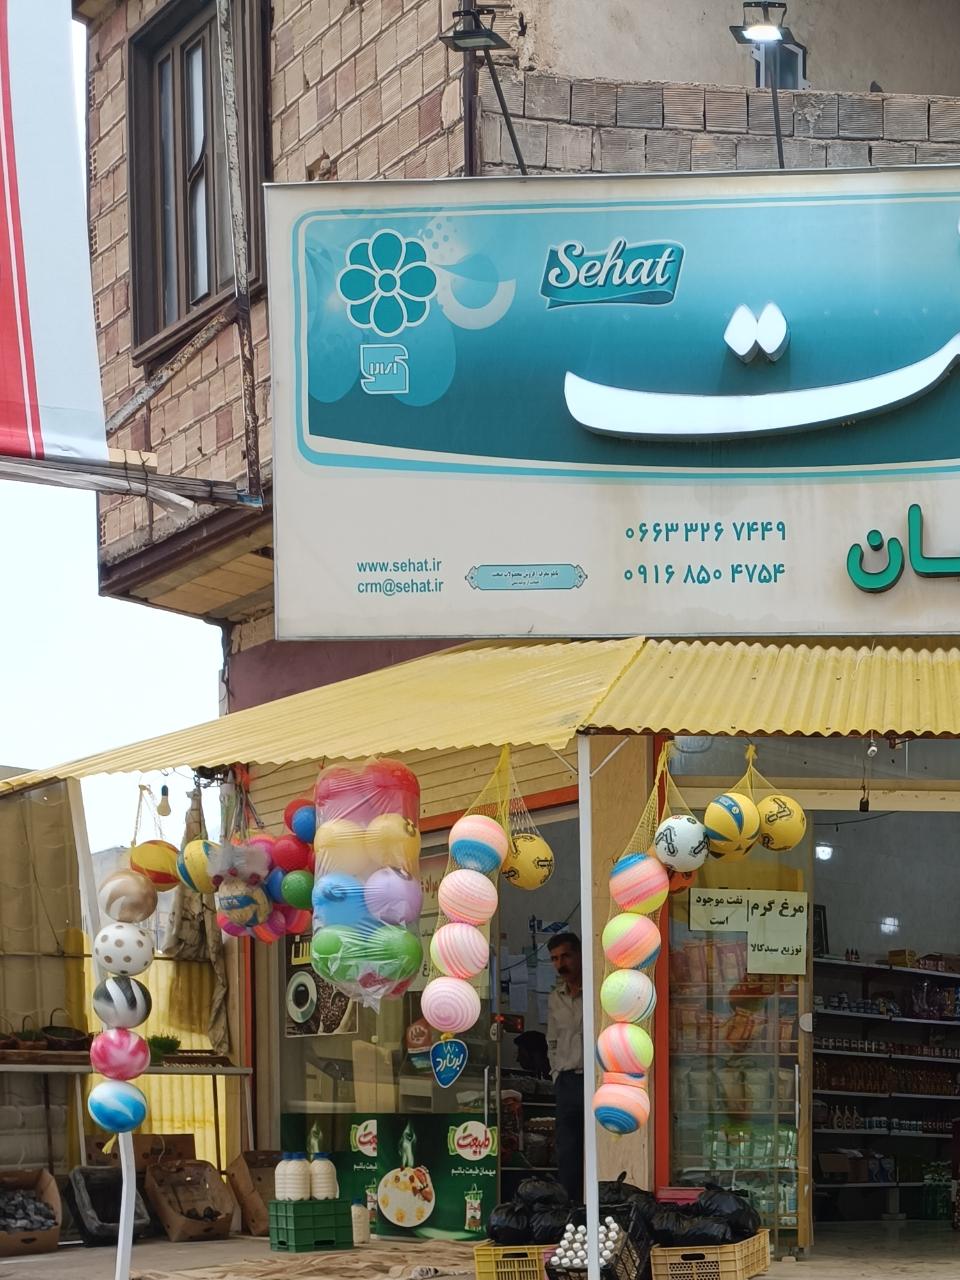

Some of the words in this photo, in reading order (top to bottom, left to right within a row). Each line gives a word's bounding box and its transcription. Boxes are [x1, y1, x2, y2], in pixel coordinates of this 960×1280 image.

[547, 237, 675, 288] Sehat
[357, 558, 442, 572] www.sehat.ir
[357, 578, 444, 596] crm@sehat.ir
[696, 895, 724, 907] موجود
[727, 896, 743, 905] نفت
[751, 900, 775, 917] گرم
[779, 898, 804, 917] مرغ
[710, 916, 728, 925] است
[781, 944, 802, 956] توزیع
[436, 1053, 464, 1073] برنارد
[456, 1129, 490, 1156] طبیعت
